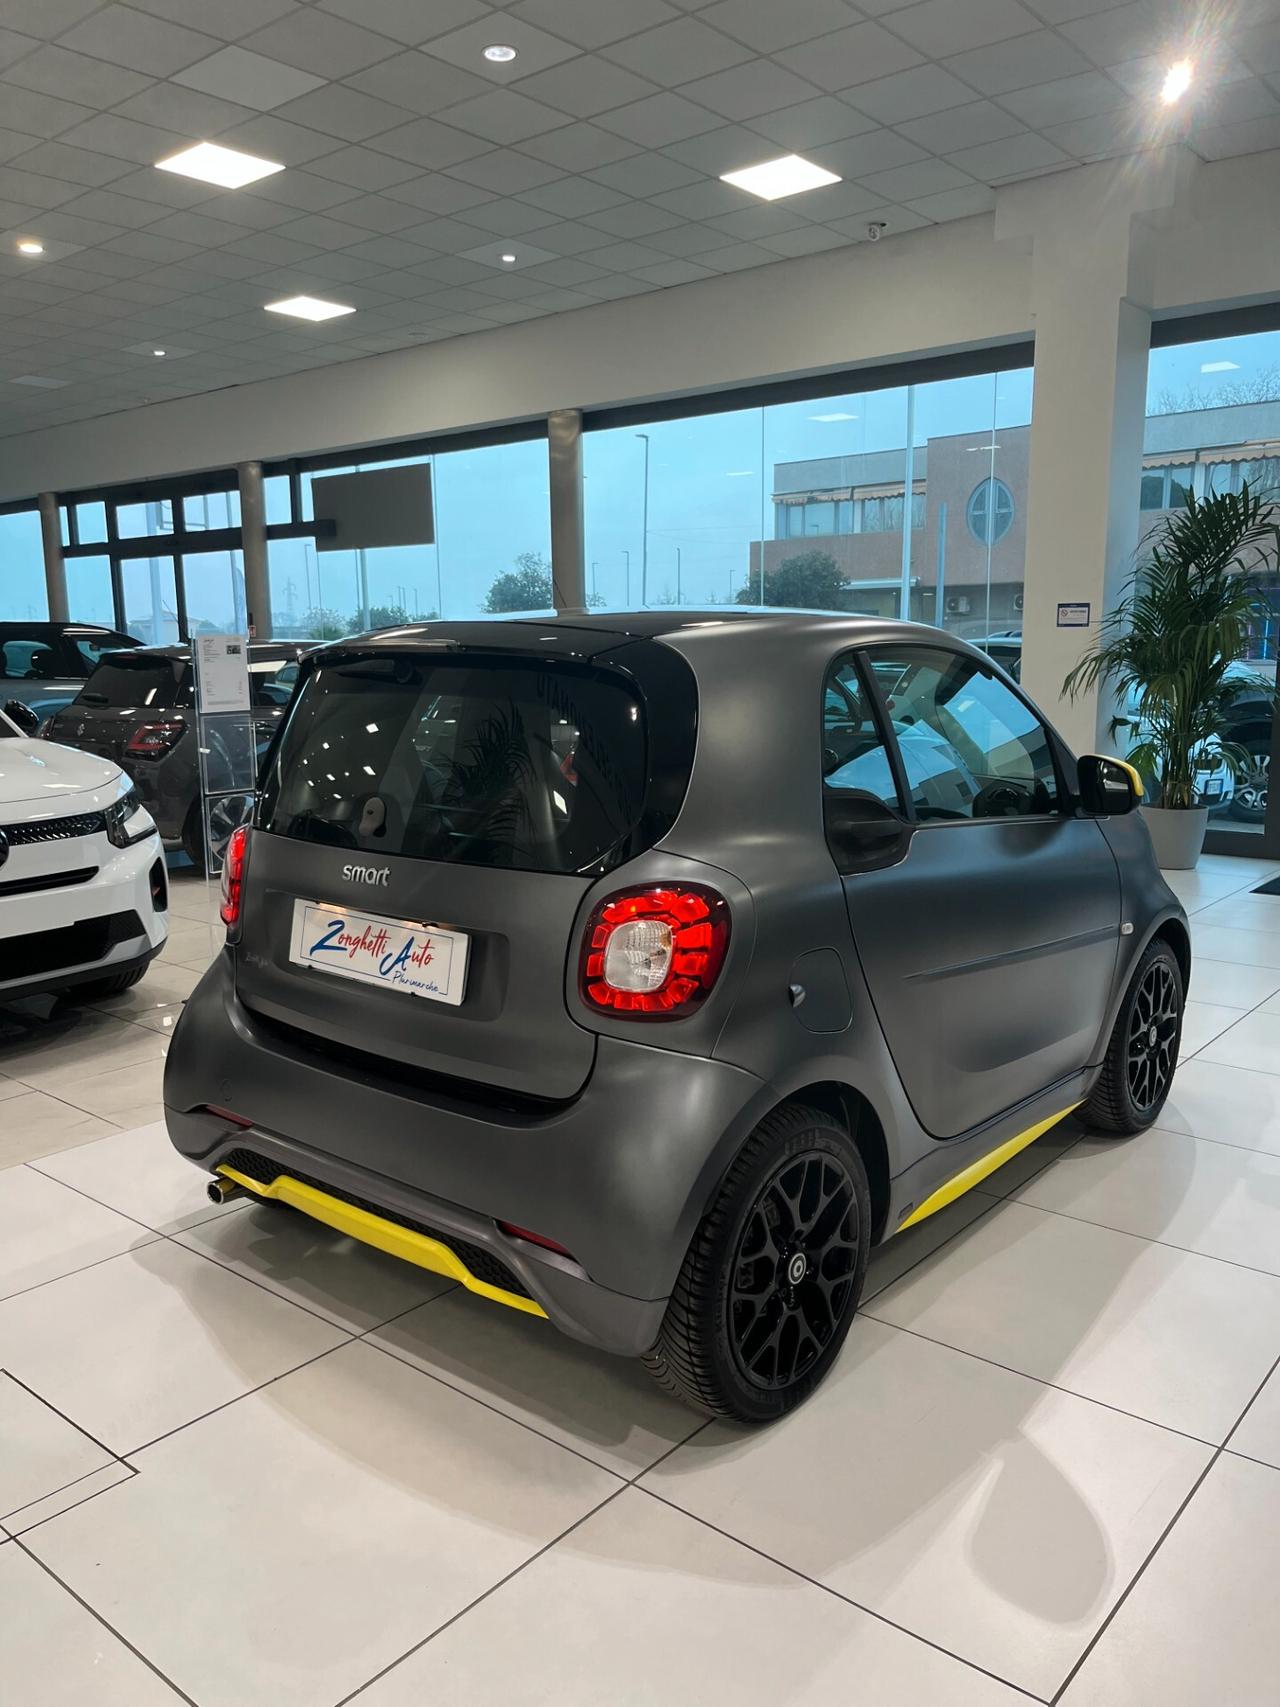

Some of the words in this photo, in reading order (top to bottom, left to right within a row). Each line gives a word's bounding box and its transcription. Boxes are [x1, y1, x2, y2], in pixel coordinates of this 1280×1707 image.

[341, 864, 391, 886] smart
[310, 920, 392, 958] Zonghetti
[379, 936, 435, 976] Auto
